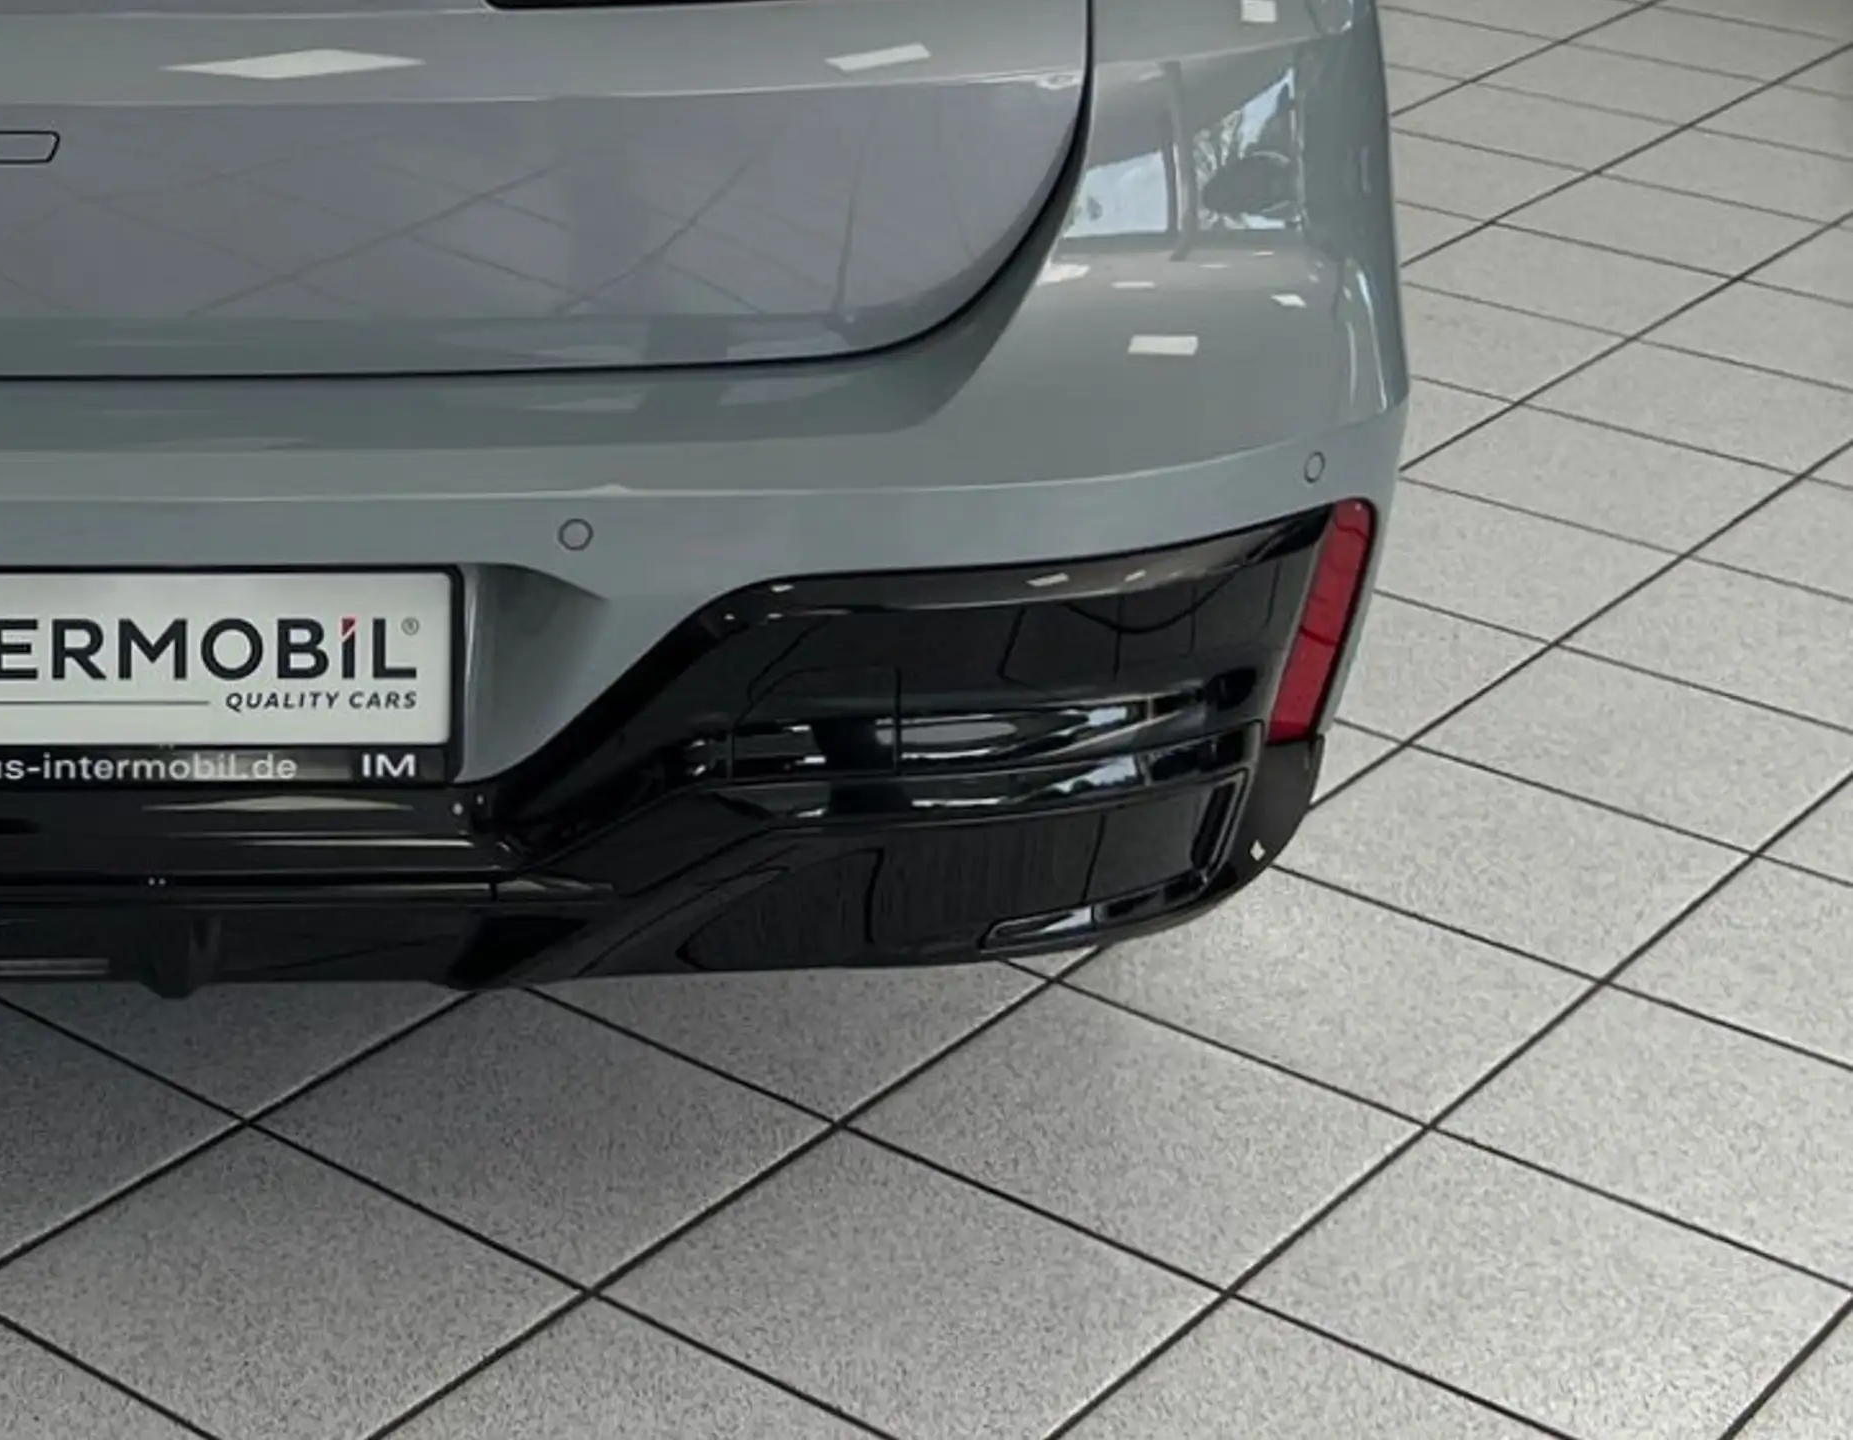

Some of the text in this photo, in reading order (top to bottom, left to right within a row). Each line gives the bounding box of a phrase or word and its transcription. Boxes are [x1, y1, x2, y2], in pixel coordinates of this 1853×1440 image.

[225, 691, 418, 712] QUALITY CARS
[361, 753, 416, 778] IM
